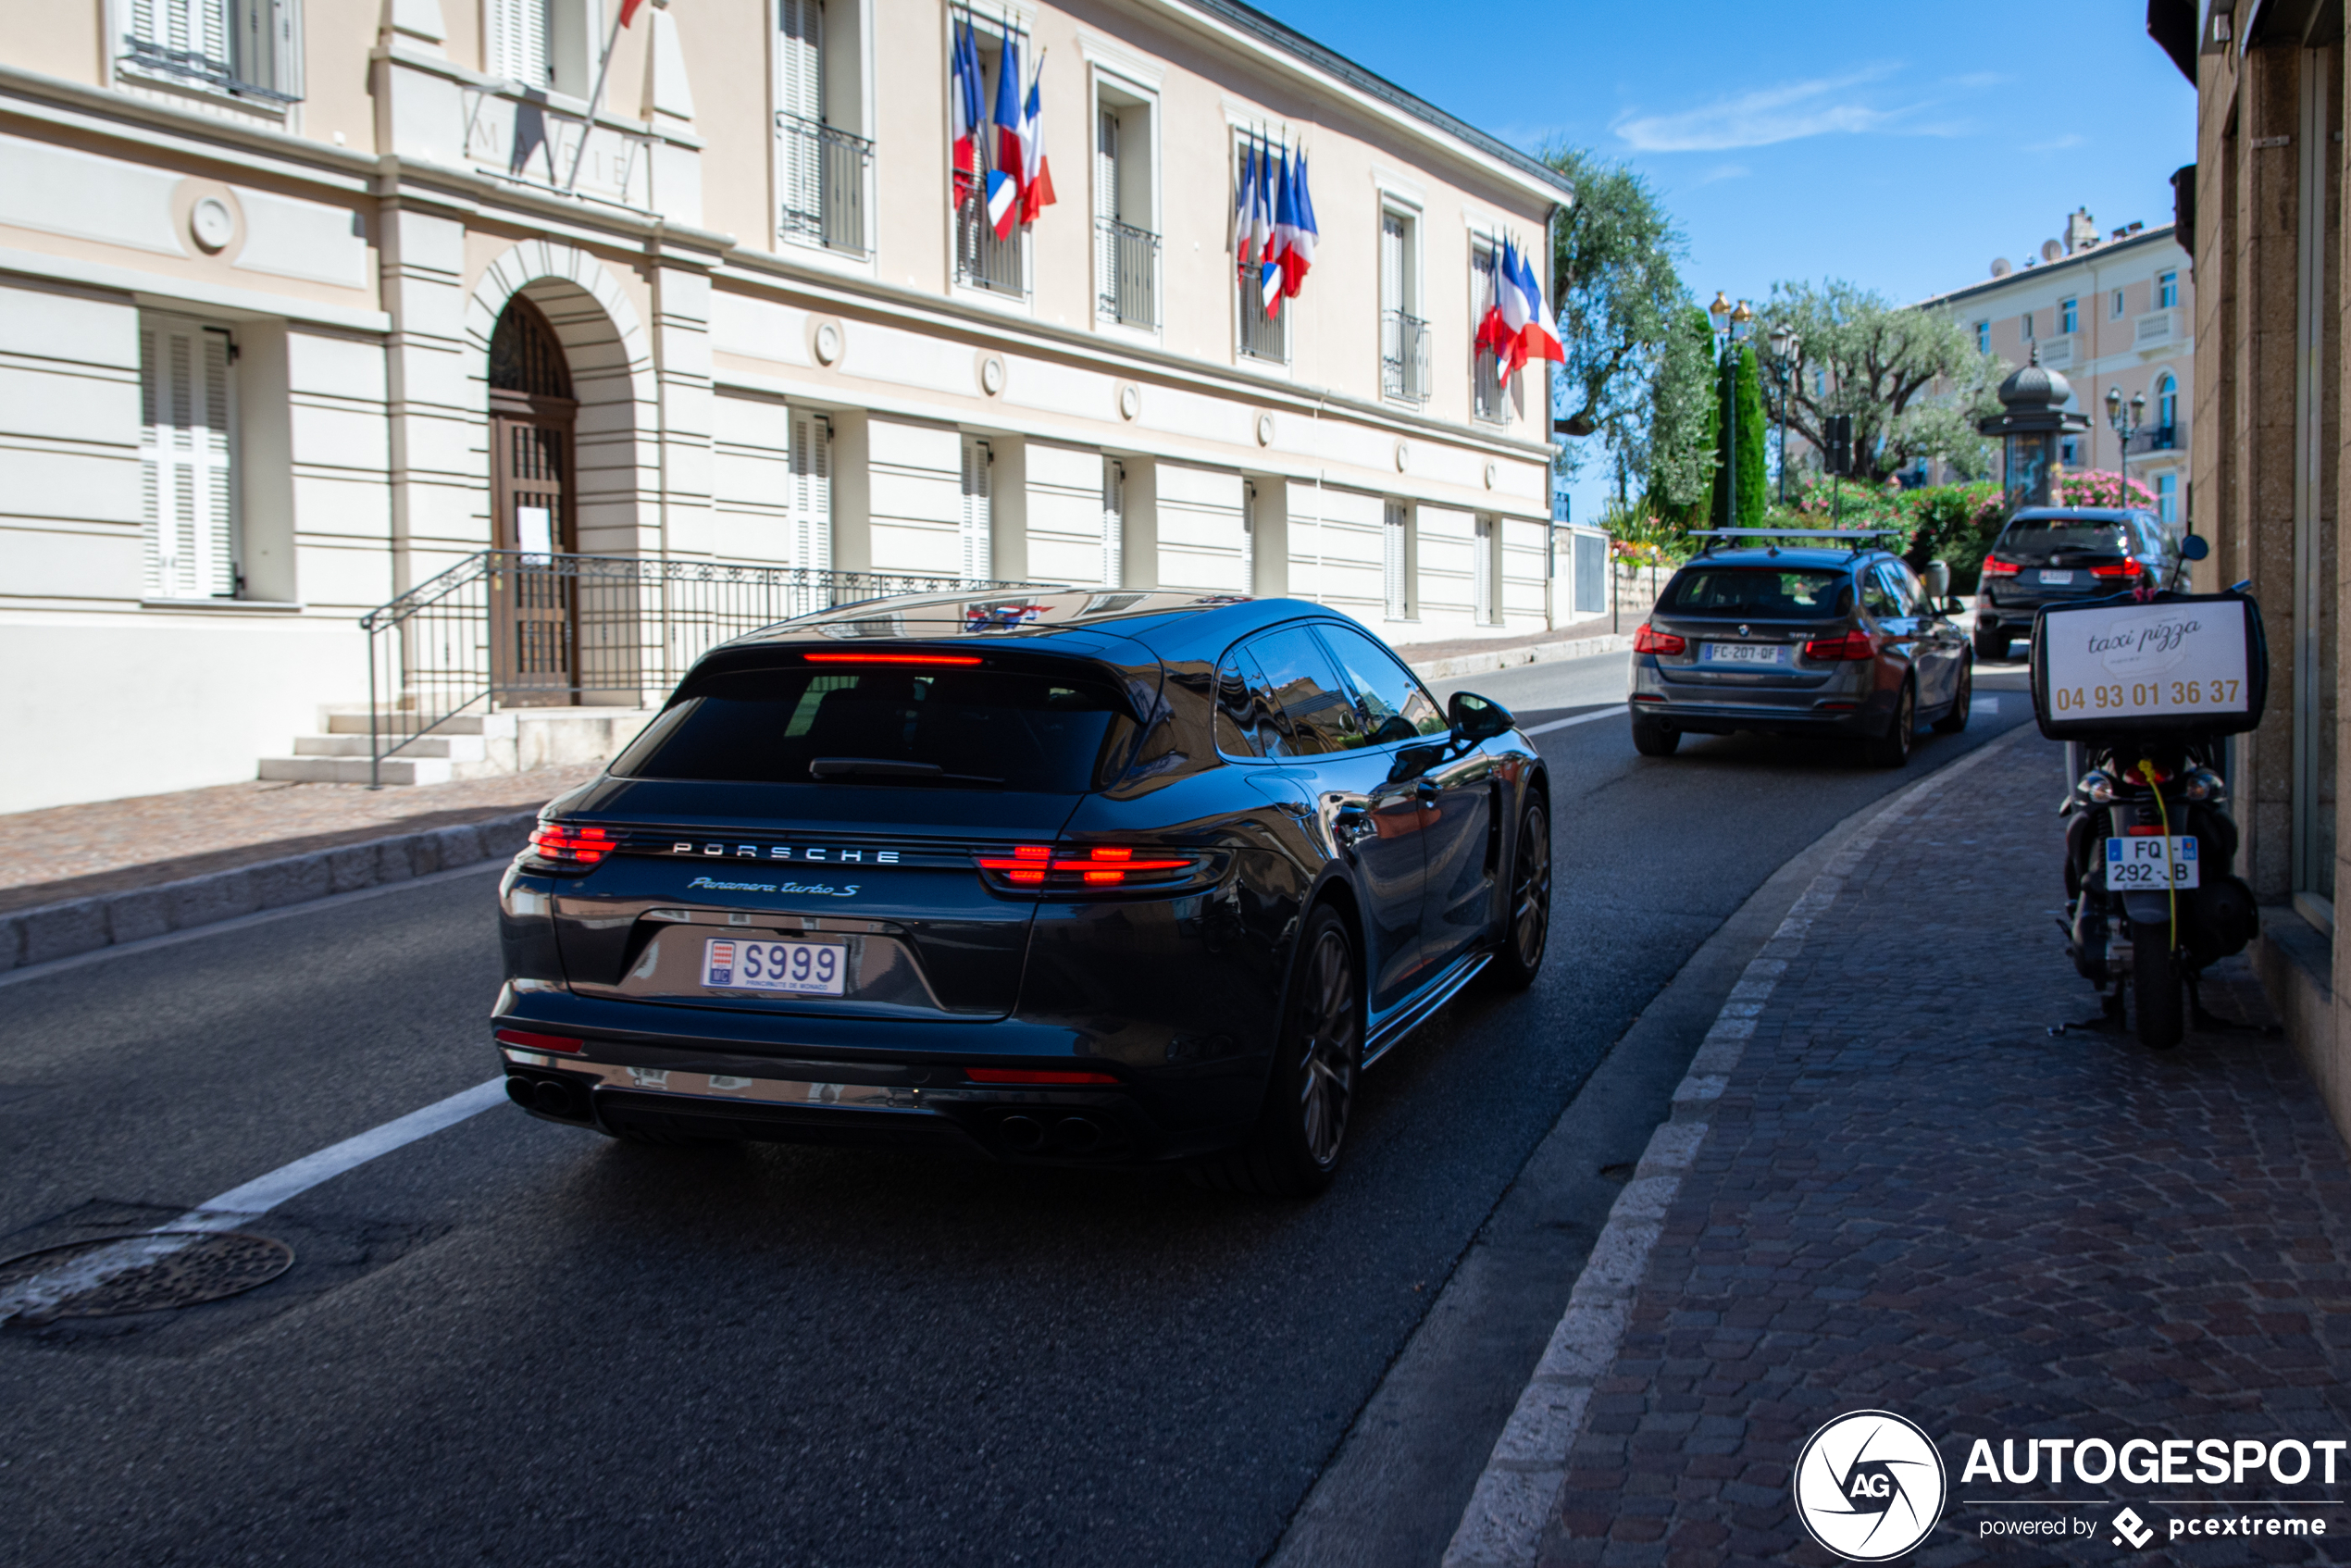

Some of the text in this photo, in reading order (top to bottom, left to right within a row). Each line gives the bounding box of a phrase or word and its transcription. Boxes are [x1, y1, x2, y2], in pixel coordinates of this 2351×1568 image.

[2088, 619, 2202, 653] taxi pizza
[2057, 679, 2240, 711] 04 93 01 36 37
[673, 842, 900, 864] PORSCHE
[688, 877, 861, 897] Panamera turbo S
[744, 944, 836, 983] S999
[713, 970, 728, 981] MC
[789, 981, 798, 989] DE
[800, 983, 828, 991] MONACO
